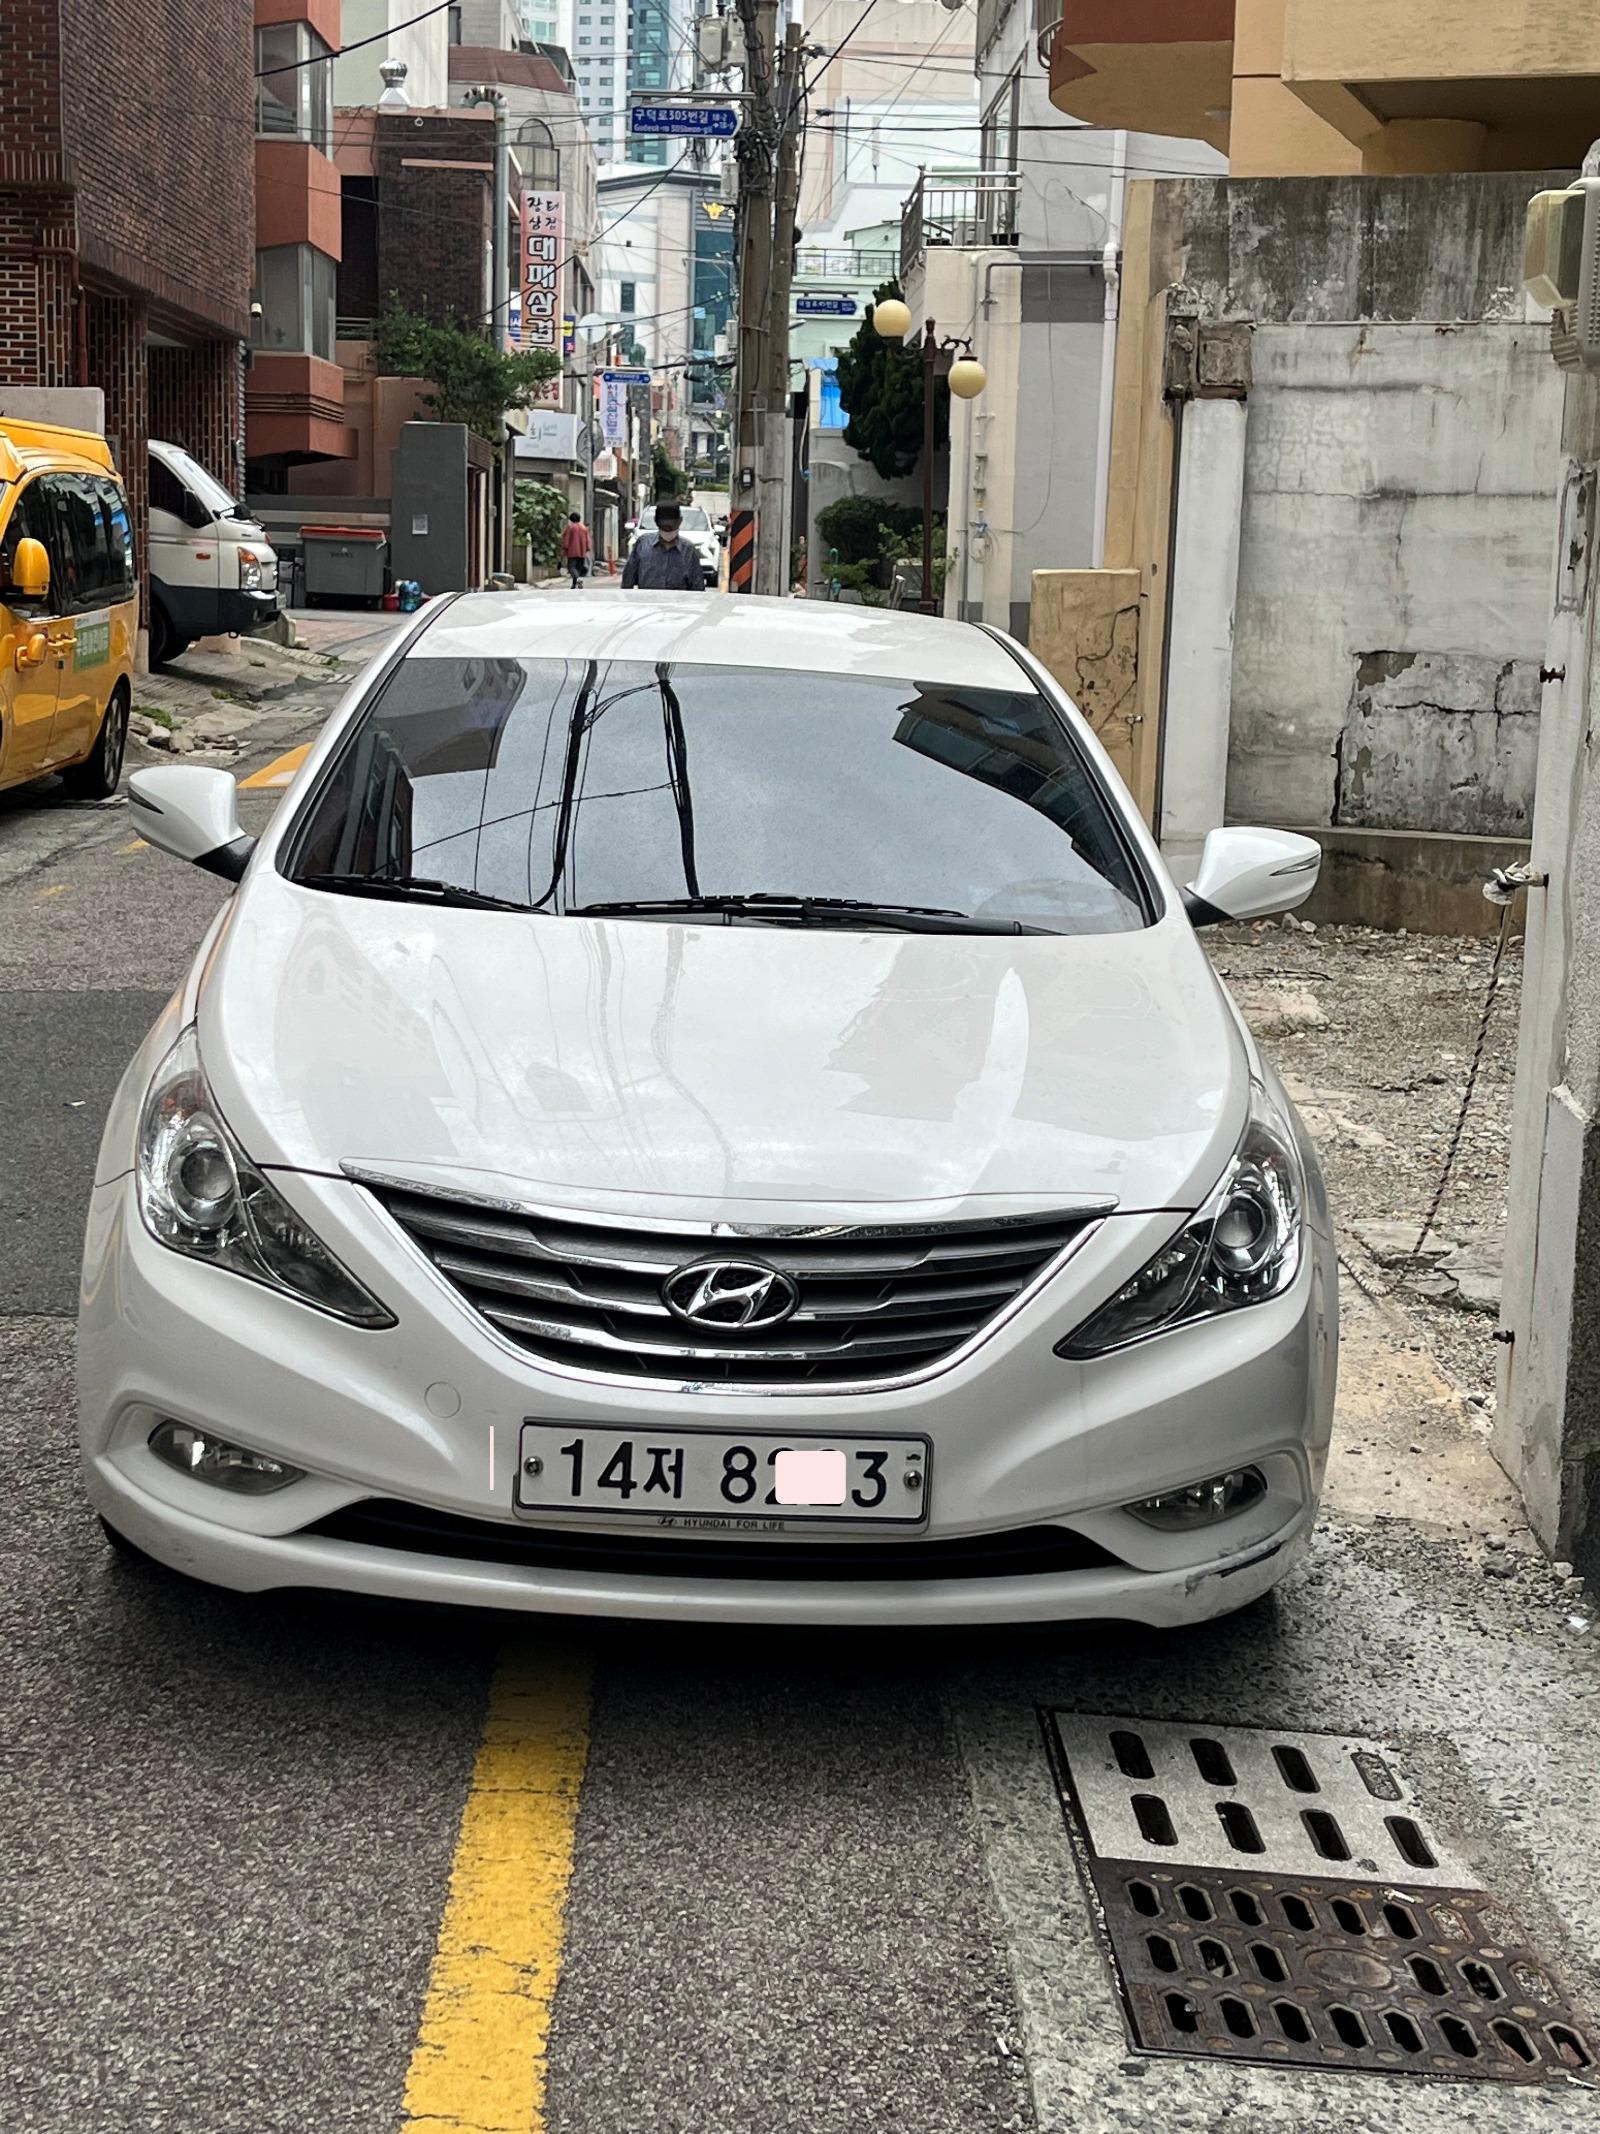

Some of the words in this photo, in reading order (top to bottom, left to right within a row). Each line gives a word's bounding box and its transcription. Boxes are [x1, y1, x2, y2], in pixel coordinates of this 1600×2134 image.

[634, 109, 709, 124] 구덕로305번길
[526, 235, 558, 354] 대패삼겹
[561, 1439, 684, 1499] 14저
[684, 1518, 731, 1529] HYUNDAI
[737, 1520, 758, 1530] FOR
[763, 1521, 785, 1532] LIFE
